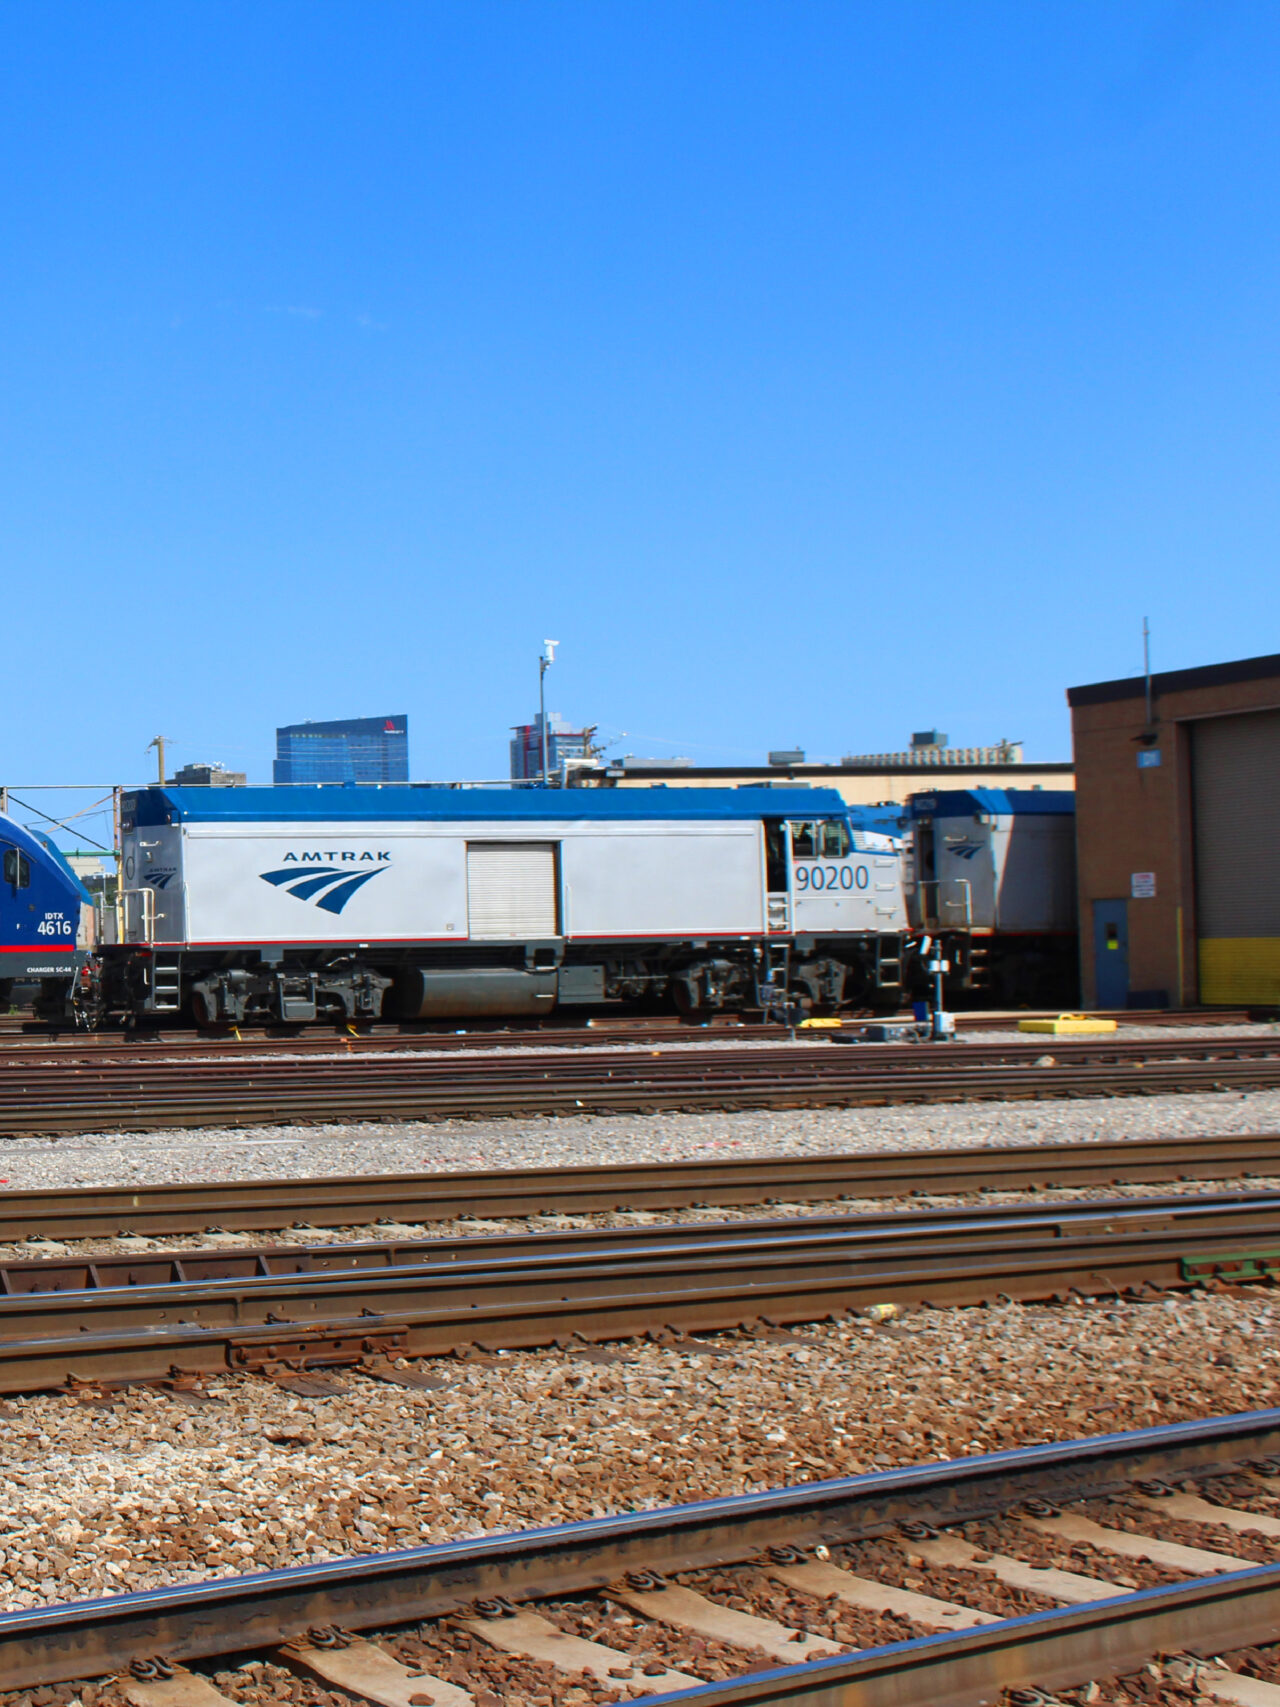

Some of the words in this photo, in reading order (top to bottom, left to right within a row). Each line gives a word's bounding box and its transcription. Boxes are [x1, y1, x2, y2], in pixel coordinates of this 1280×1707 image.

[283, 851, 391, 862] AMTRAK
[795, 865, 869, 891] 90200
[44, 912, 64, 920] IDTX
[37, 920, 72, 936] 4616
